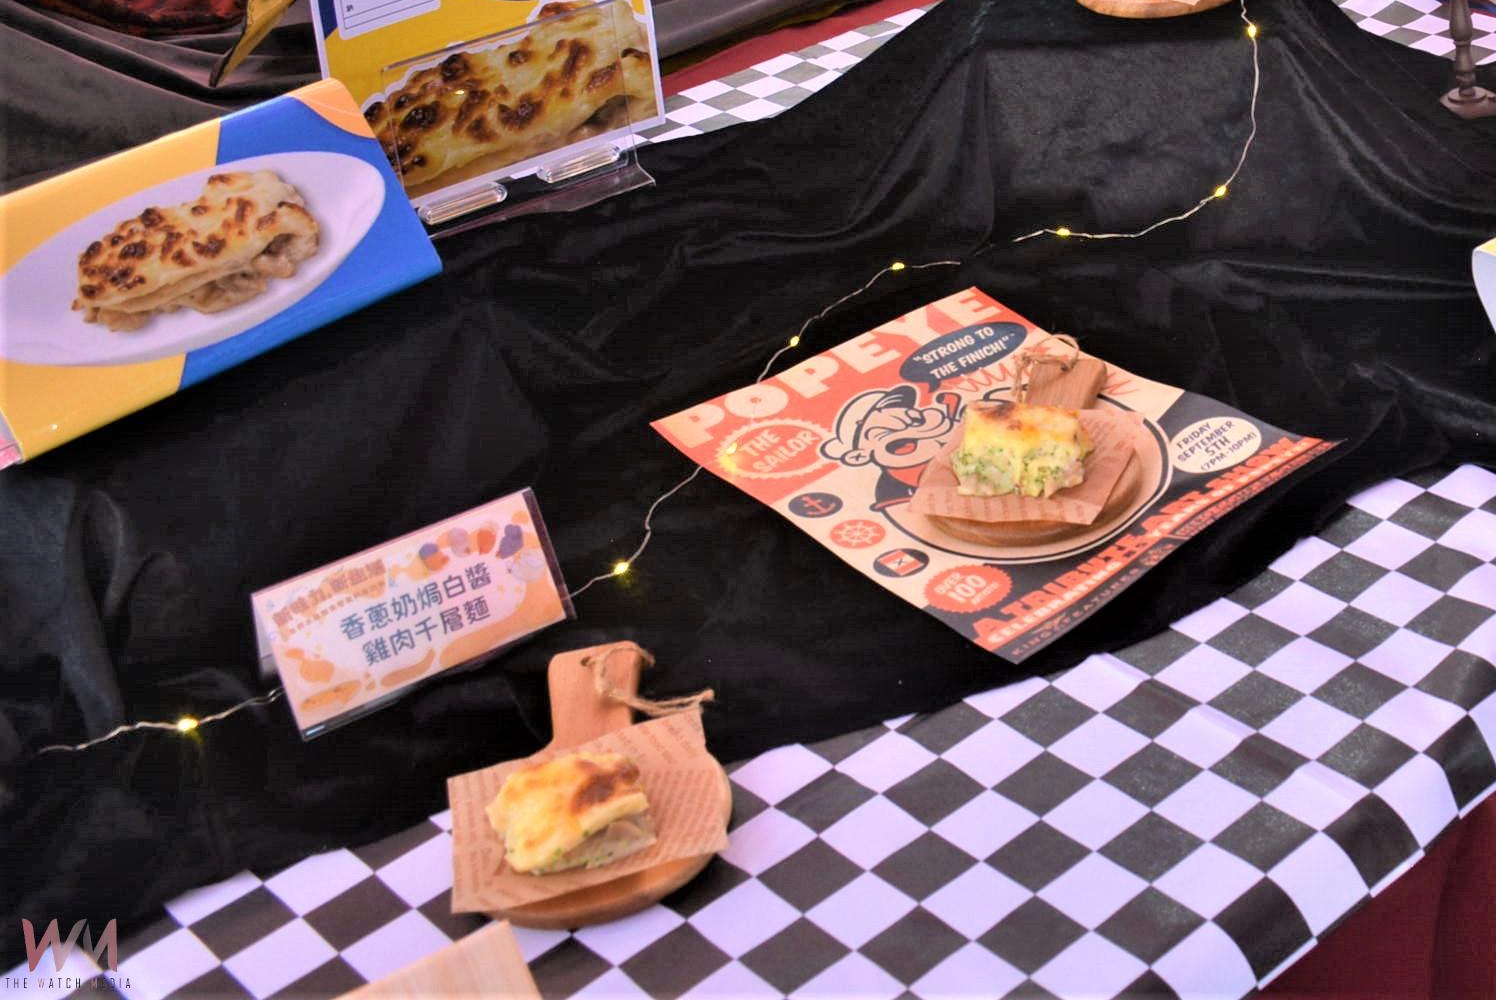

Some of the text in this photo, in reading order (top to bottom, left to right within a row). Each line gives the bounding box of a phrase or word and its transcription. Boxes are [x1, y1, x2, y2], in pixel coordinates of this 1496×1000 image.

[974, 326, 995, 340] TO
[660, 288, 1003, 448] POPEYE
[930, 361, 959, 380] THE
[738, 428, 783, 457] THE
[1176, 421, 1212, 449] FRIDAY
[1177, 420, 1235, 462] SEPTEMBER
[1204, 435, 1231, 456] 5TH
[751, 429, 819, 474] SAILOR
[340, 562, 491, 640] 香蔥奶焗白醬
[947, 575, 987, 604] 100
[362, 595, 491, 666] 雞肉千層麵
